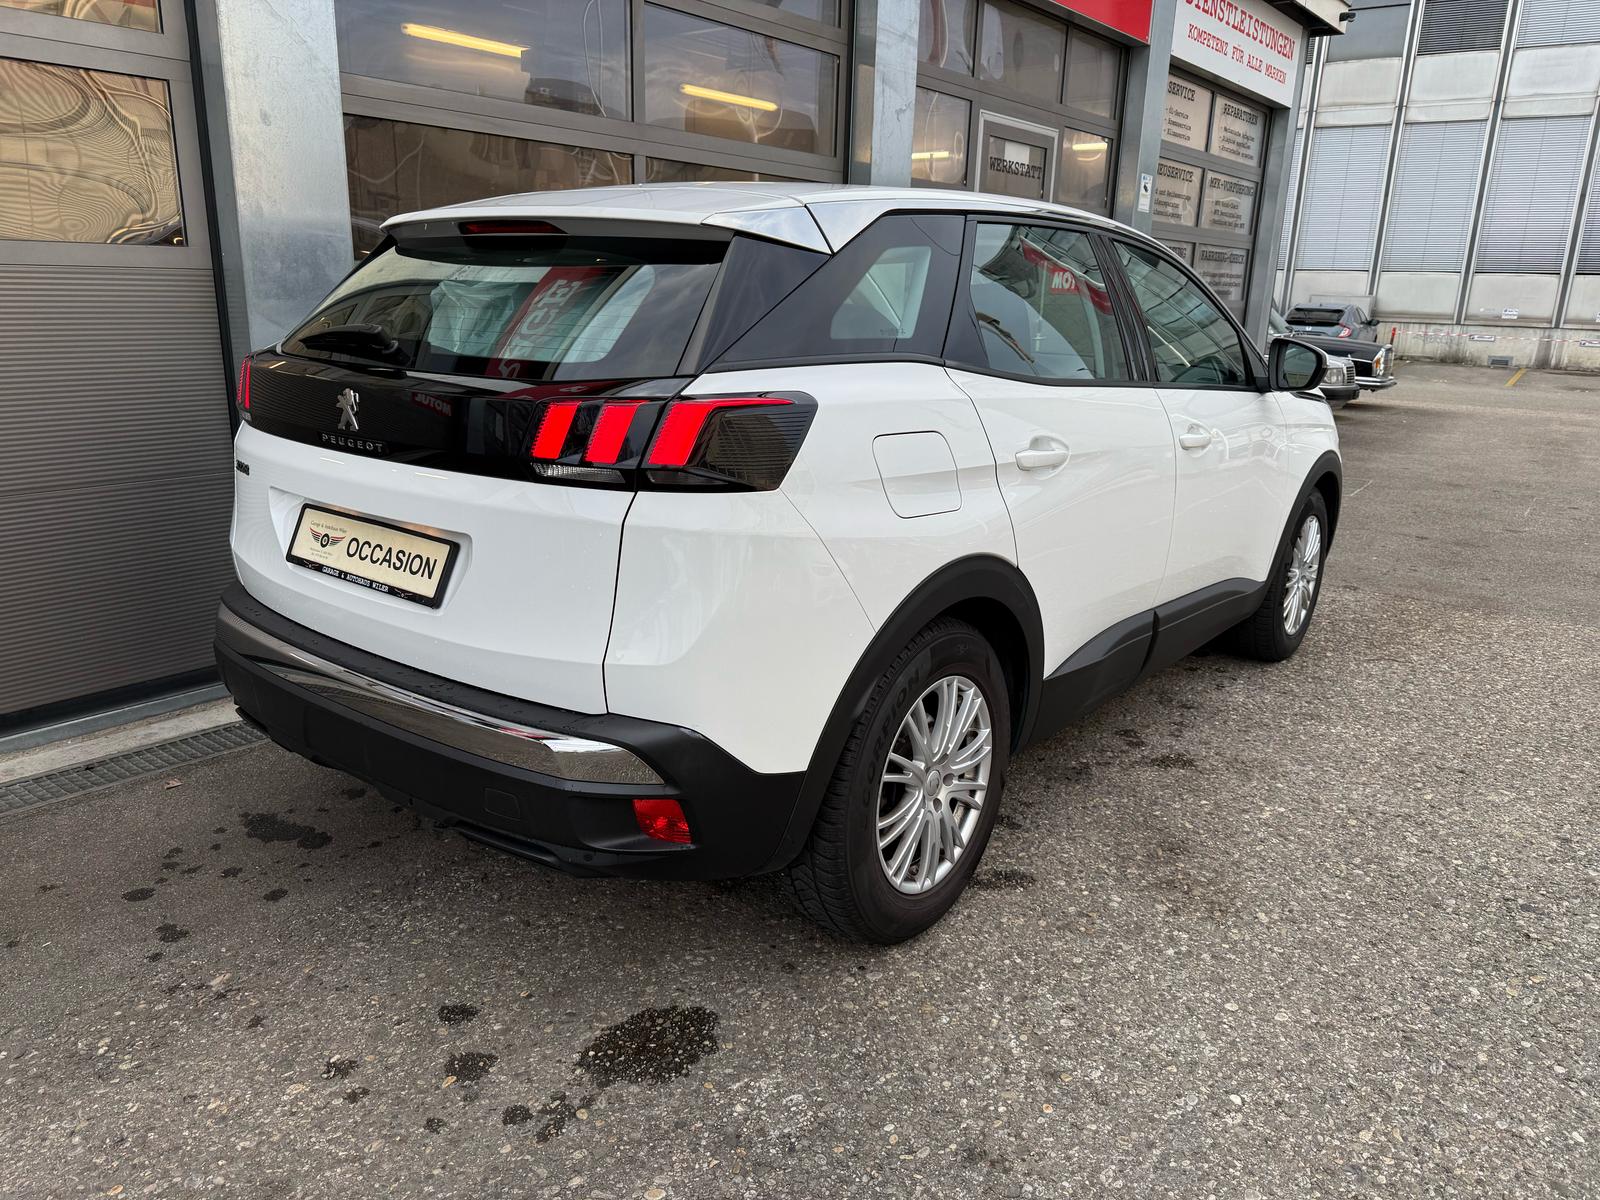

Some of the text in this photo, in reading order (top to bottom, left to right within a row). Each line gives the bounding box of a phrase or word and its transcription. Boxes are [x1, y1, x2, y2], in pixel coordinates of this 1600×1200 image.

[1186, 0, 1295, 61] ENSTLEISTUNGEN
[1188, 23, 1286, 85] KOMPETENZ FÜR ALLE MARKEN
[1167, 80, 1196, 102] SERVICE
[1223, 103, 1259, 126] REPARATUREN
[988, 155, 1042, 179] WERKSTATT
[322, 433, 383, 452] PEUGEOT
[346, 537, 438, 580] OCCASION
[321, 566, 340, 577] GARAGE
[345, 573, 371, 587] AUTOHAUS
[372, 581, 389, 593] WILER
